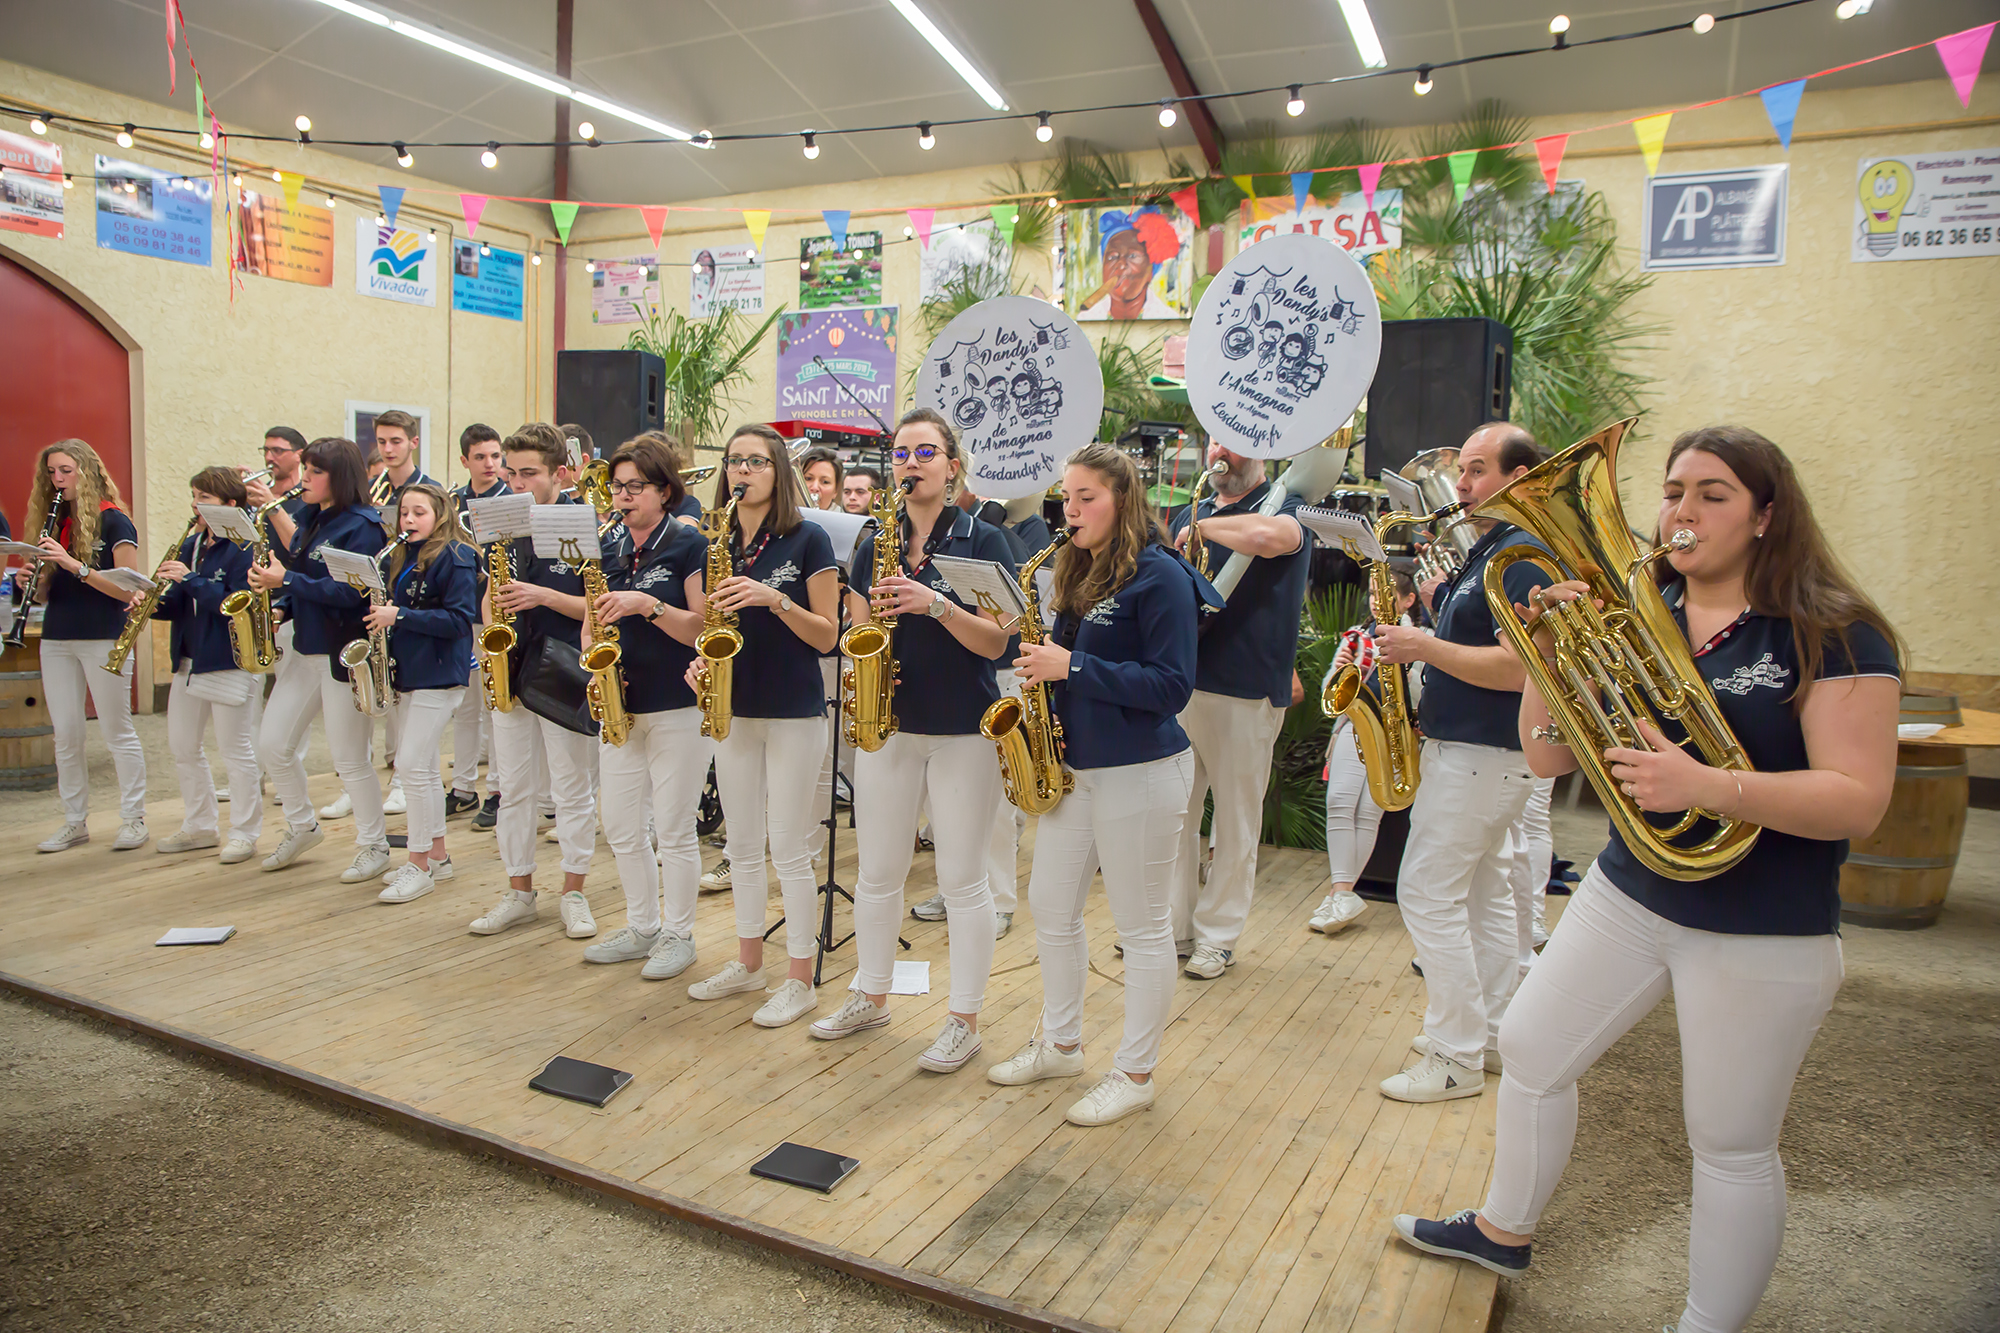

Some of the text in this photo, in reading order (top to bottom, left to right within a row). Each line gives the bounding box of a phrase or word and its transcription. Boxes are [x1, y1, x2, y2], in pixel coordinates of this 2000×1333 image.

[1916, 158, 1965, 170] Electricité
[1942, 174, 1993, 184] Ramonage
[114, 221, 202, 246] 05 62 09 38 46
[1254, 211, 1388, 251] SSA
[1902, 231, 1920, 247] 06
[1925, 230, 1944, 246] 82
[1948, 228, 1968, 244] 36
[1972, 227, 1992, 244] 65
[114, 234, 202, 258] 06 09 81 28 46
[807, 234, 875, 254] Jean-Piee TONNIS
[370, 275, 429, 297] Vivadour
[1293, 274, 1318, 299] les
[741, 298, 750, 310] 21
[753, 298, 762, 309] 78
[1272, 288, 1329, 322] Dandy's
[995, 327, 1018, 347] les
[980, 340, 1039, 366] Dandy's
[836, 362, 852, 371] MARS
[1244, 369, 1260, 386] de
[834, 383, 892, 405] MONT
[1218, 371, 1294, 416] l'Armagnac
[791, 410, 838, 419] VIGNOBLE
[841, 410, 854, 418] EN
[1212, 402, 1282, 448] Lesdandys.fr
[805, 428, 822, 439] nord
[972, 429, 1053, 454] l'Armagnac
[992, 423, 1008, 438] de
[976, 452, 1055, 481] Lesdandys.fr
